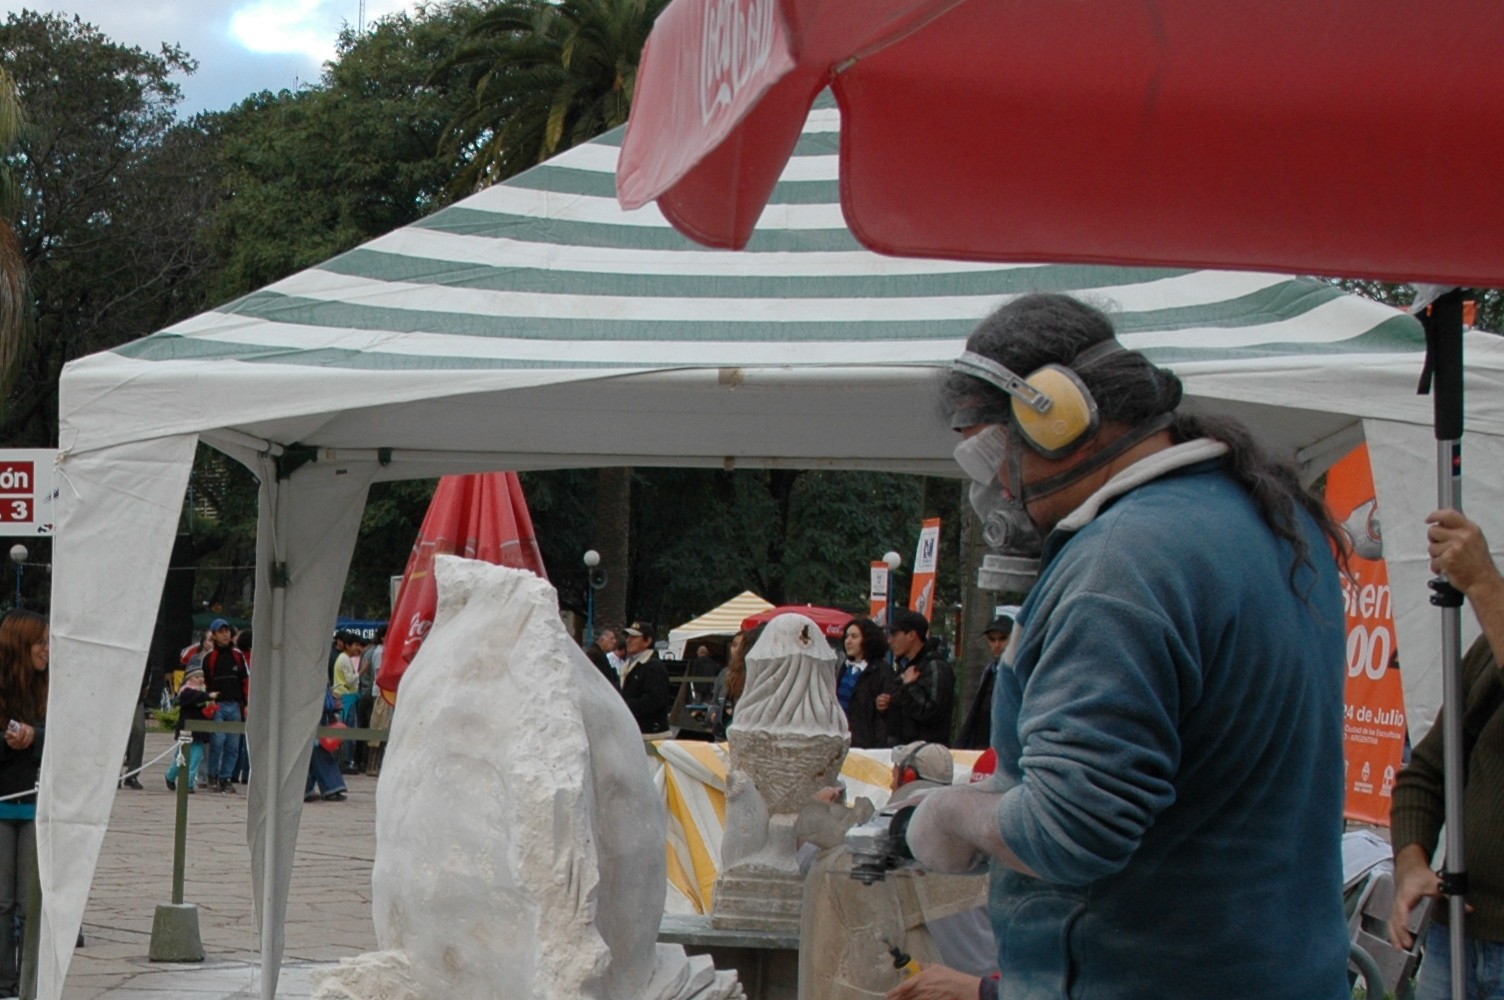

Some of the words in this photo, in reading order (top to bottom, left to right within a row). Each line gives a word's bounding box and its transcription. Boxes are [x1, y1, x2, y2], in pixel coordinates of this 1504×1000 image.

[11, 500, 27, 520] 3
[1346, 624, 1400, 680] 00
[1356, 706, 1372, 723] de
[1374, 708, 1404, 728] Julio
